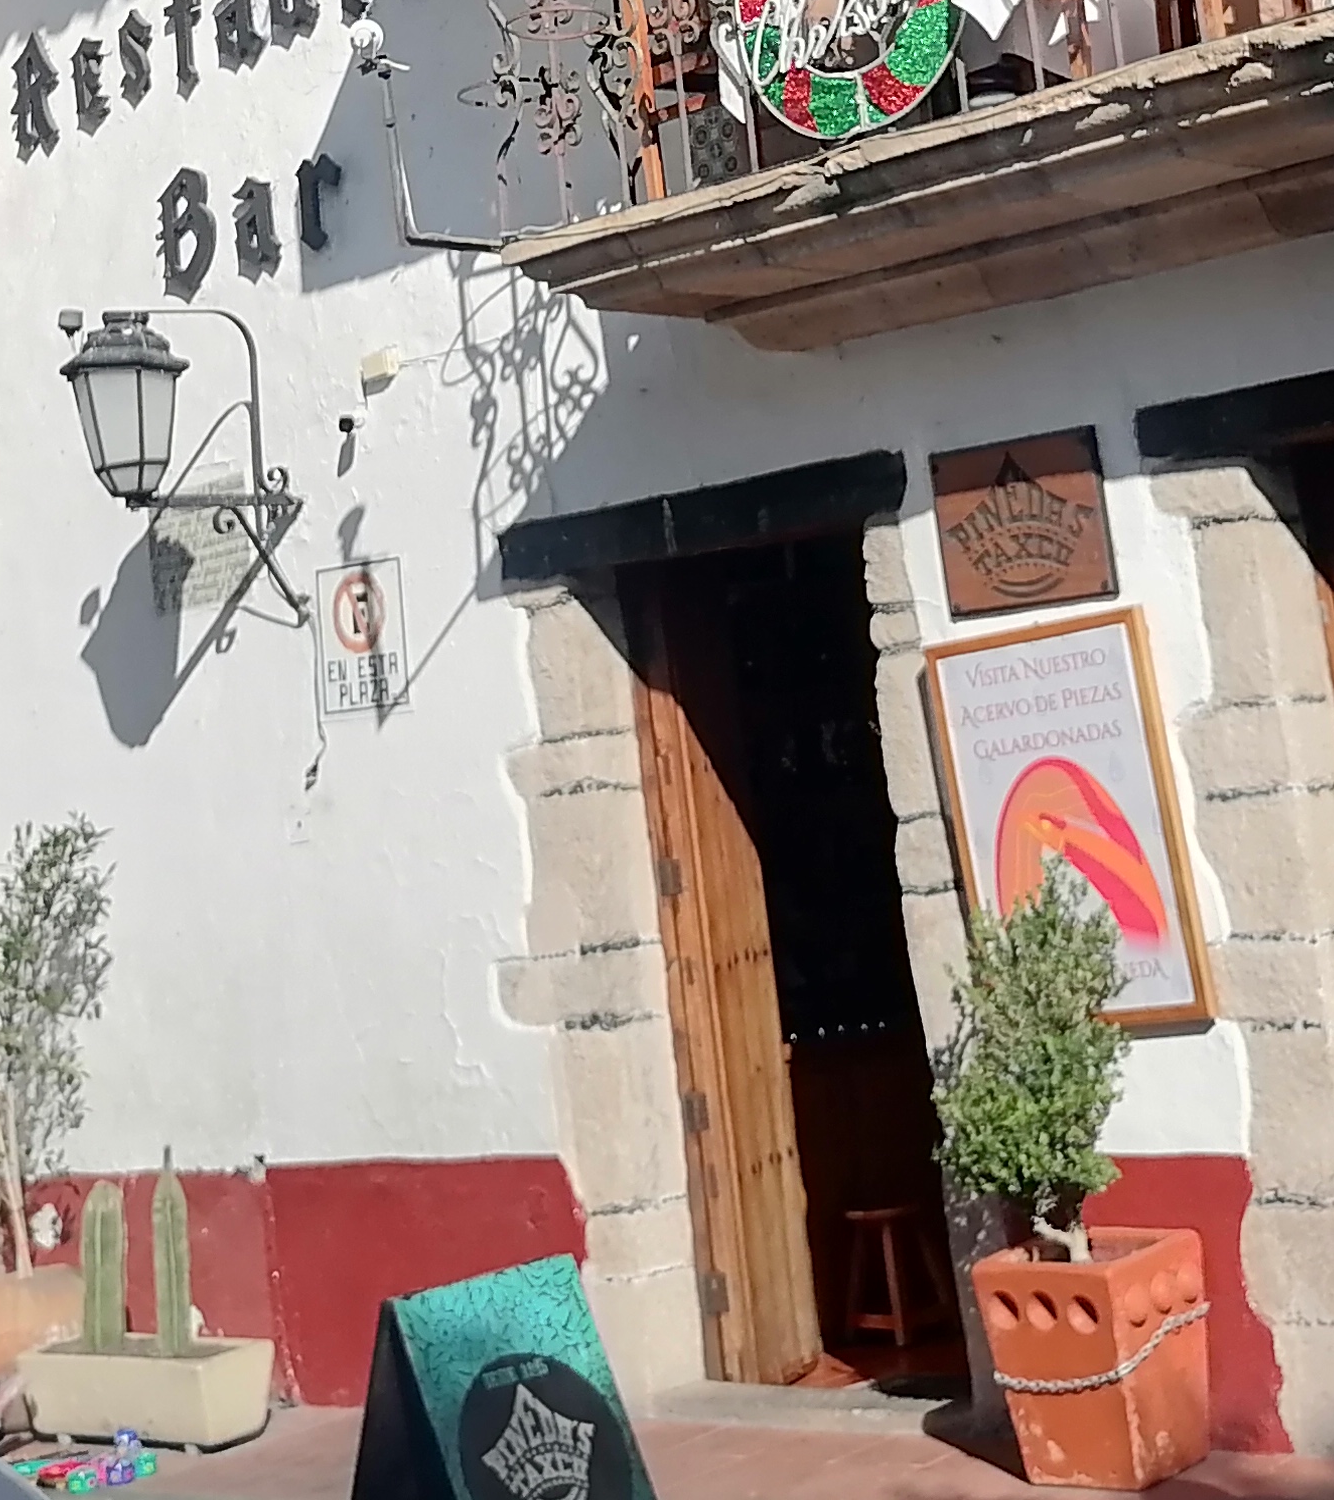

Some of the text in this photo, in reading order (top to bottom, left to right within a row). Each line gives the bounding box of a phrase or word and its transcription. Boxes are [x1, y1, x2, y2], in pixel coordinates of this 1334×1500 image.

[156, 165, 343, 305] Bar
[971, 531, 1075, 578] TAXCO
[327, 651, 399, 683] EN ESTA
[965, 647, 1107, 689] VISITA NUESTRO
[339, 677, 390, 708] PLAZA
[960, 681, 1123, 729] ACERVO DE PIEZAS
[972, 718, 1123, 762] GALARDONADAS
